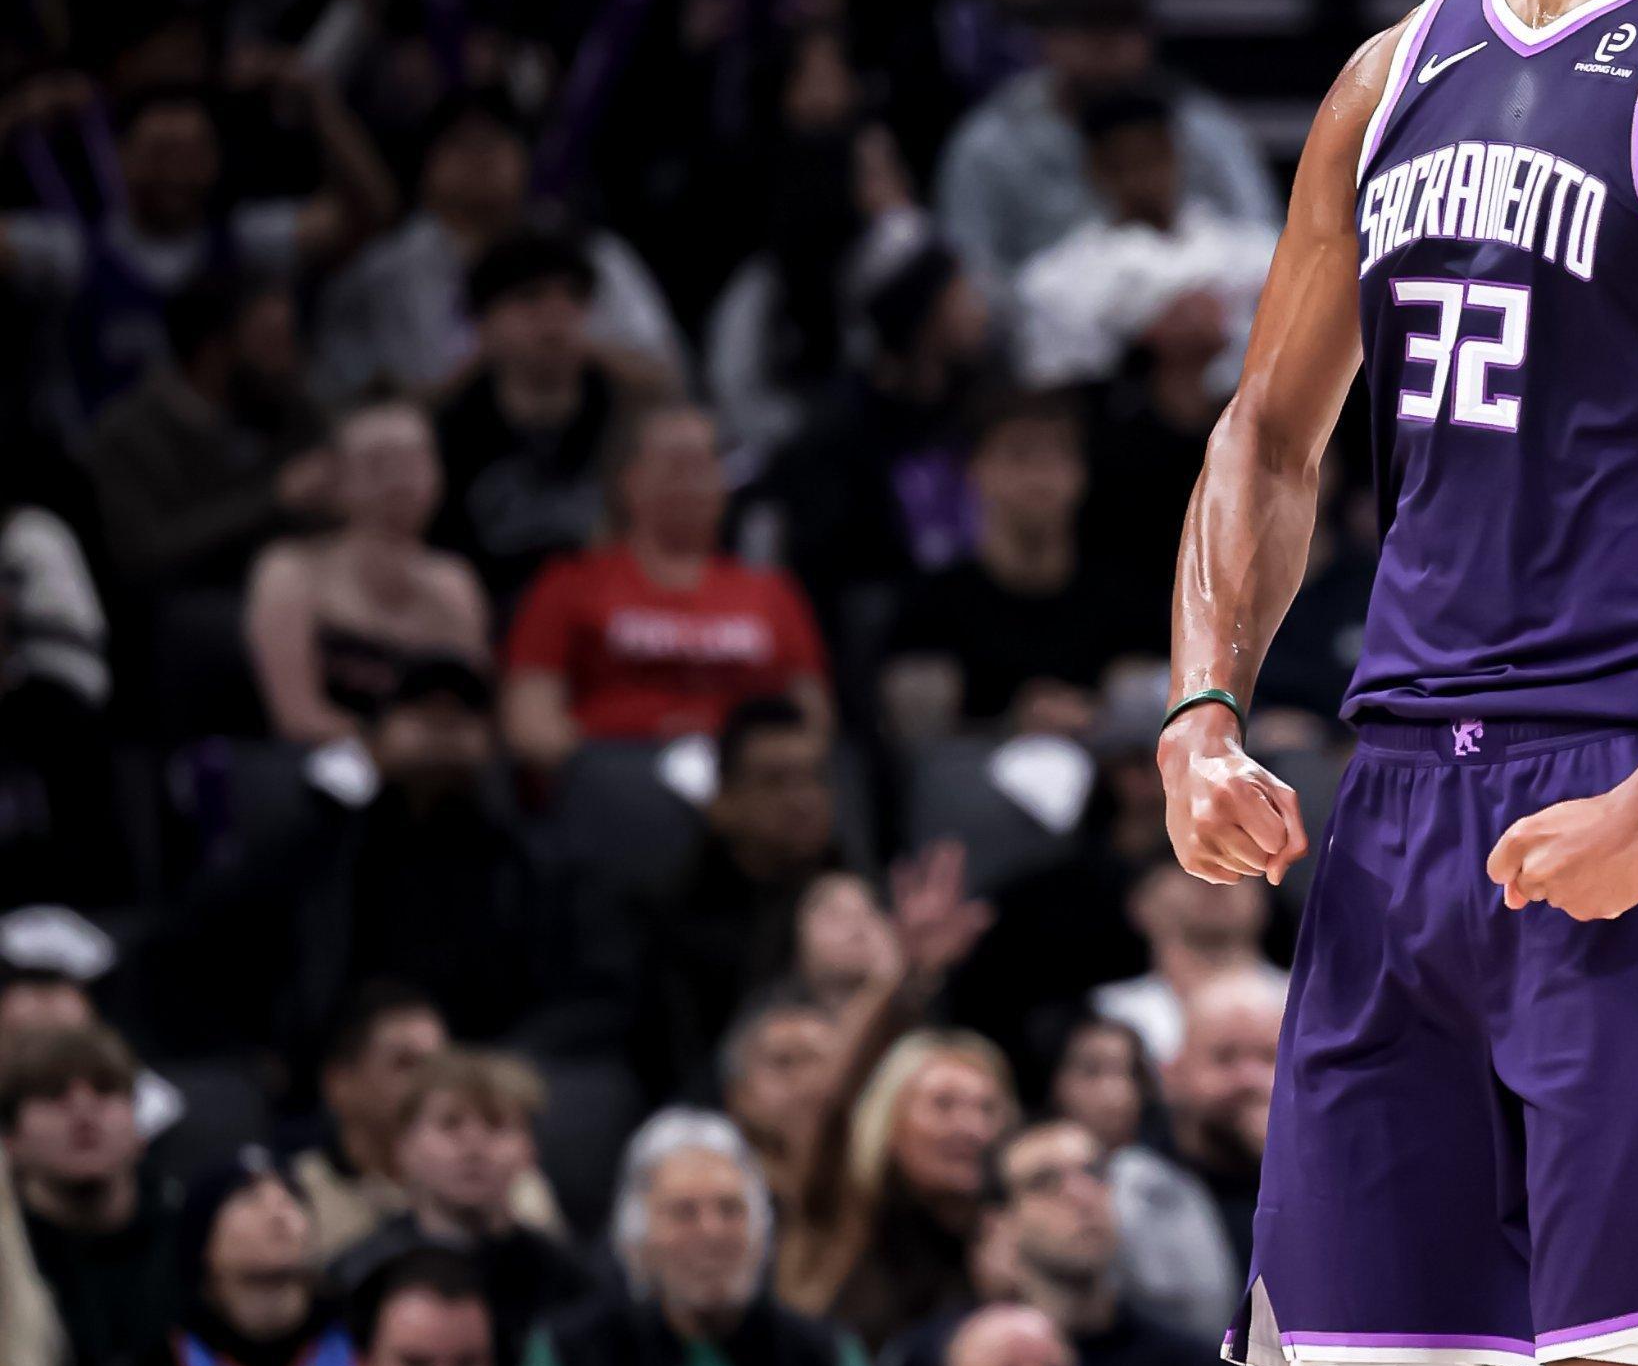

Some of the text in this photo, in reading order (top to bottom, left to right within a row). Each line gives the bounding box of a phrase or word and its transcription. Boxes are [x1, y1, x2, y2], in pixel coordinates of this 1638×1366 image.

[1610, 66, 1633, 78] LAW
[1359, 140, 1608, 282] SACRAMENTO
[1388, 277, 1532, 433] 32
